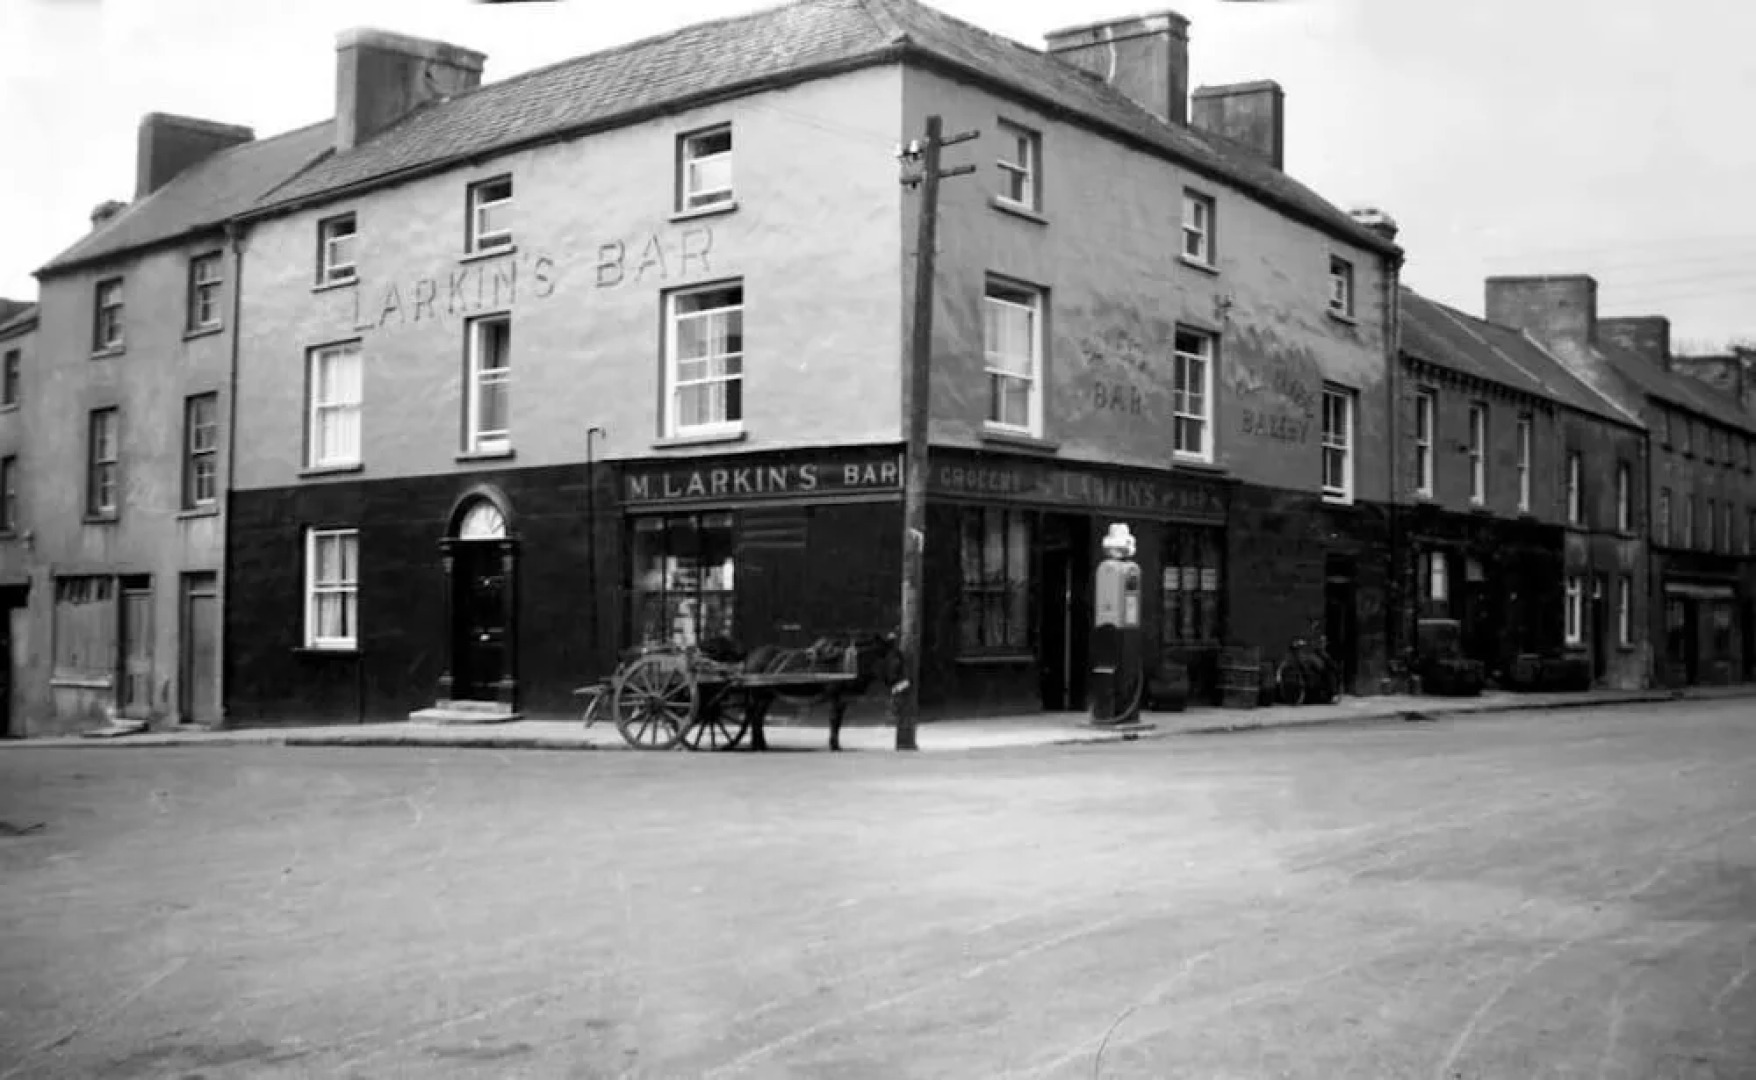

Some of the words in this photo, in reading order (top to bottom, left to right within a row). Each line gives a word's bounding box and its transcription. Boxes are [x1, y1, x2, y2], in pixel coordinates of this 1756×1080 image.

[353, 256, 555, 332] LARKIN'S
[596, 225, 714, 288] BAR
[662, 463, 818, 498] LARKIN'S
[843, 461, 898, 485] BAR
